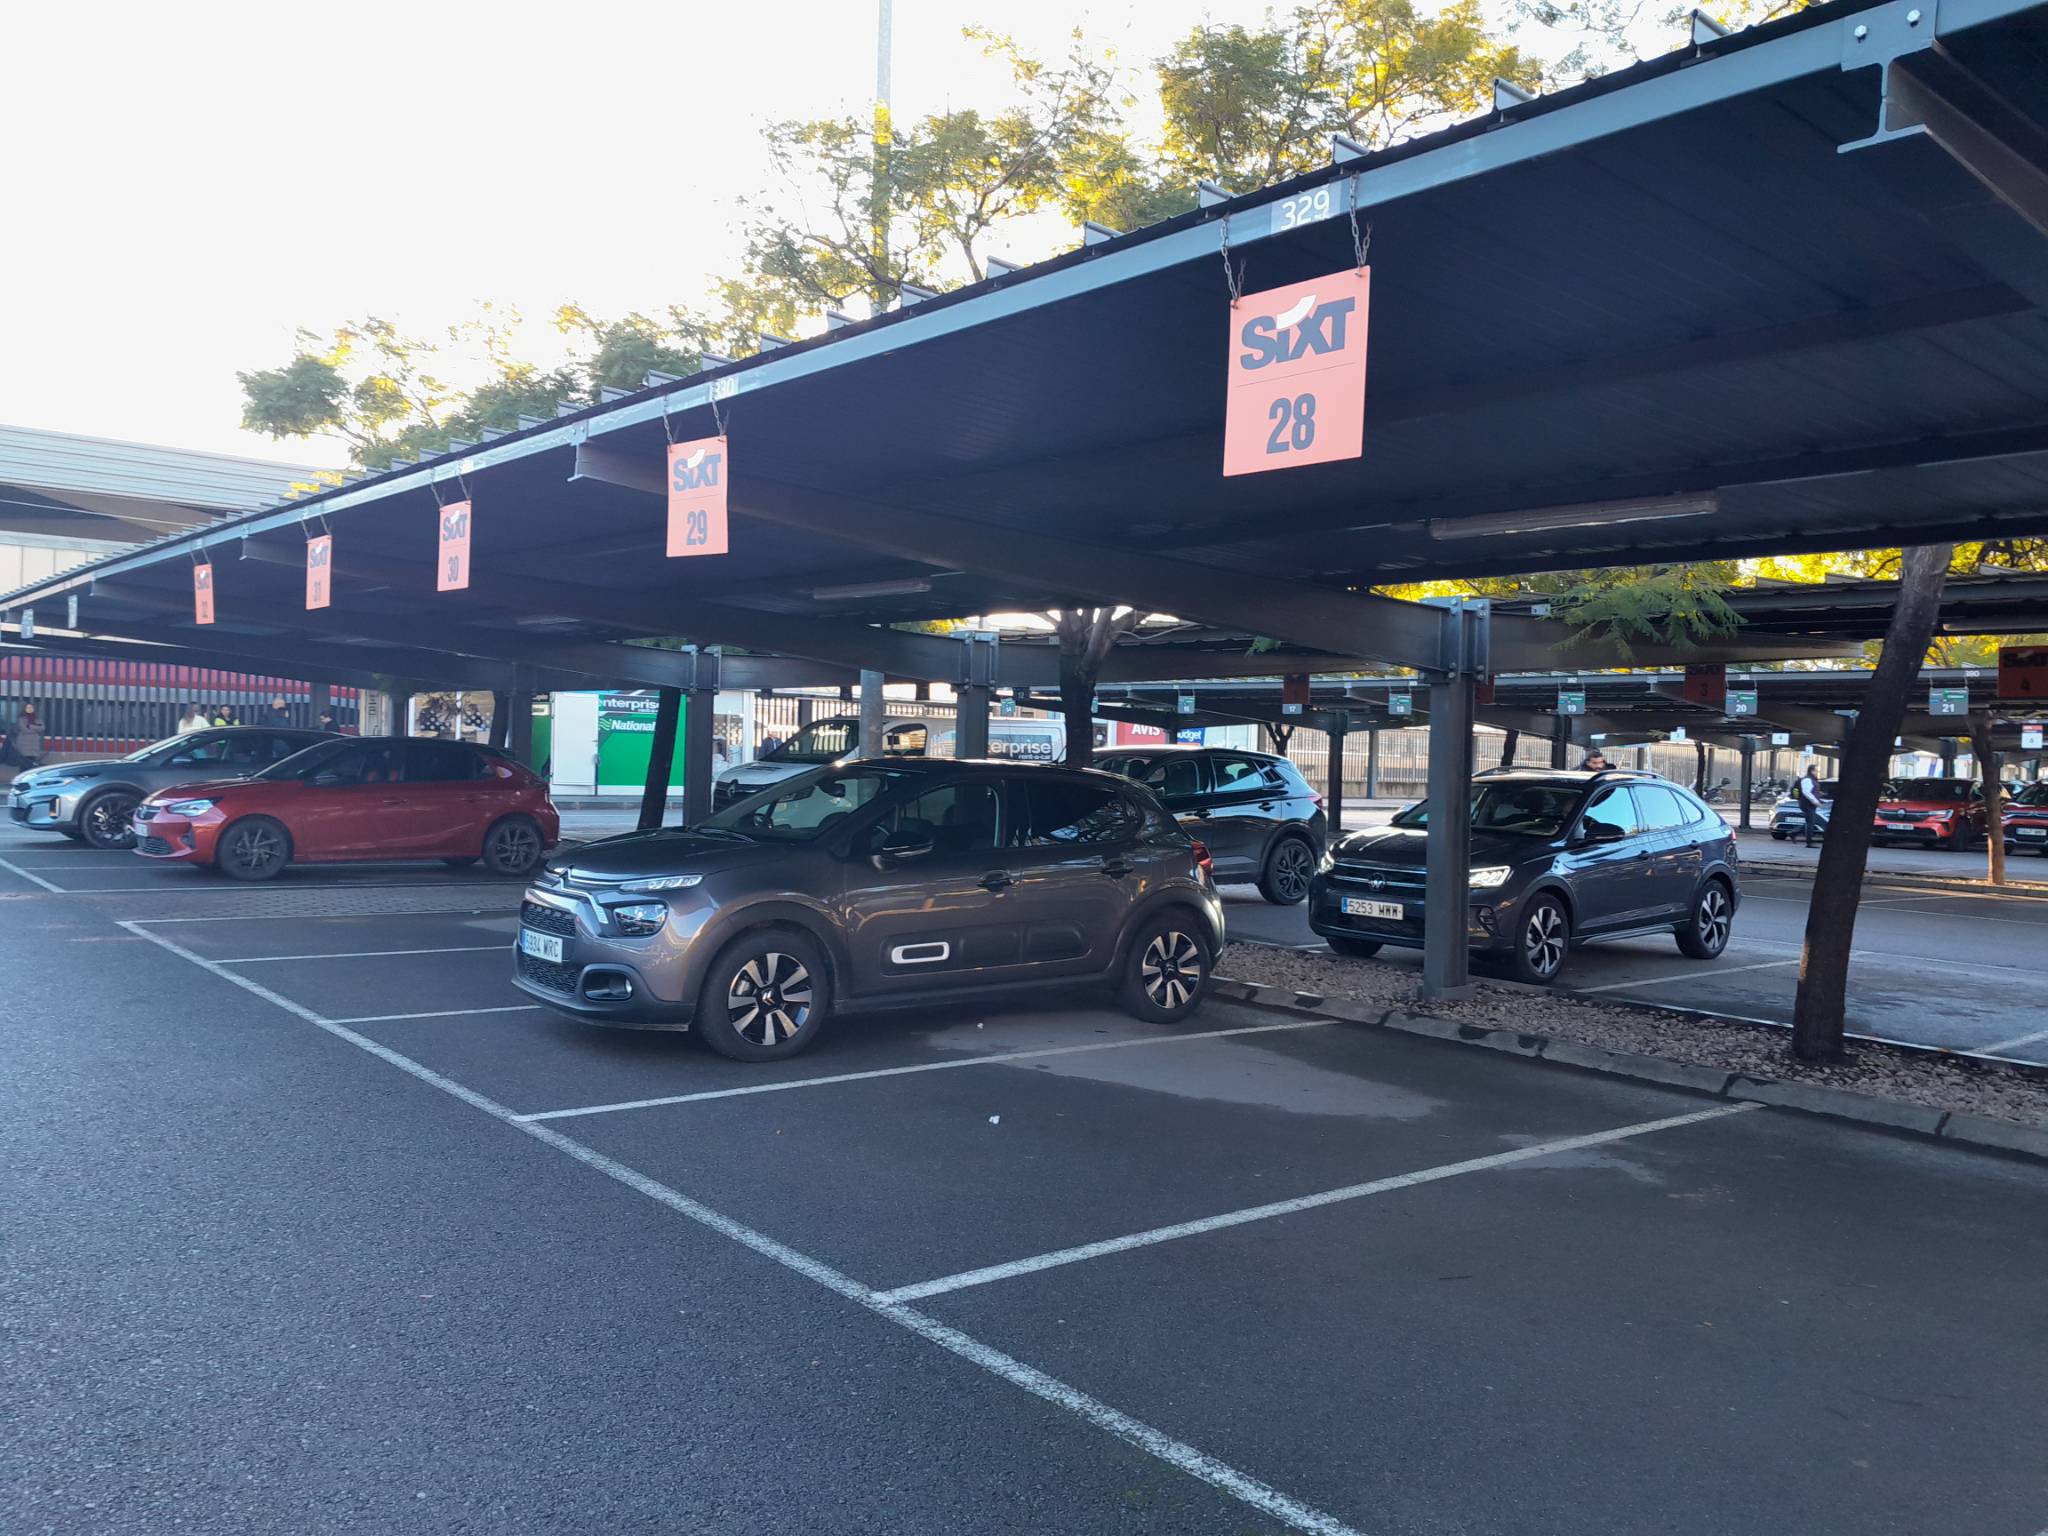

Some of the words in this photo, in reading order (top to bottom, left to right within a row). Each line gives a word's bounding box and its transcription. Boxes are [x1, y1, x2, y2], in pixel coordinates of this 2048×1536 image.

[1280, 189, 1330, 231] 329
[1266, 392, 1317, 455] 28
[686, 509, 708, 546] 29
[447, 556, 459, 583] 30
[1735, 704, 1748, 713] 20
[1941, 703, 1955, 713] 21
[611, 719, 657, 731] National
[1177, 729, 1202, 742] udget
[987, 739, 1052, 757] erprise
[1348, 900, 1374, 915] 5253
